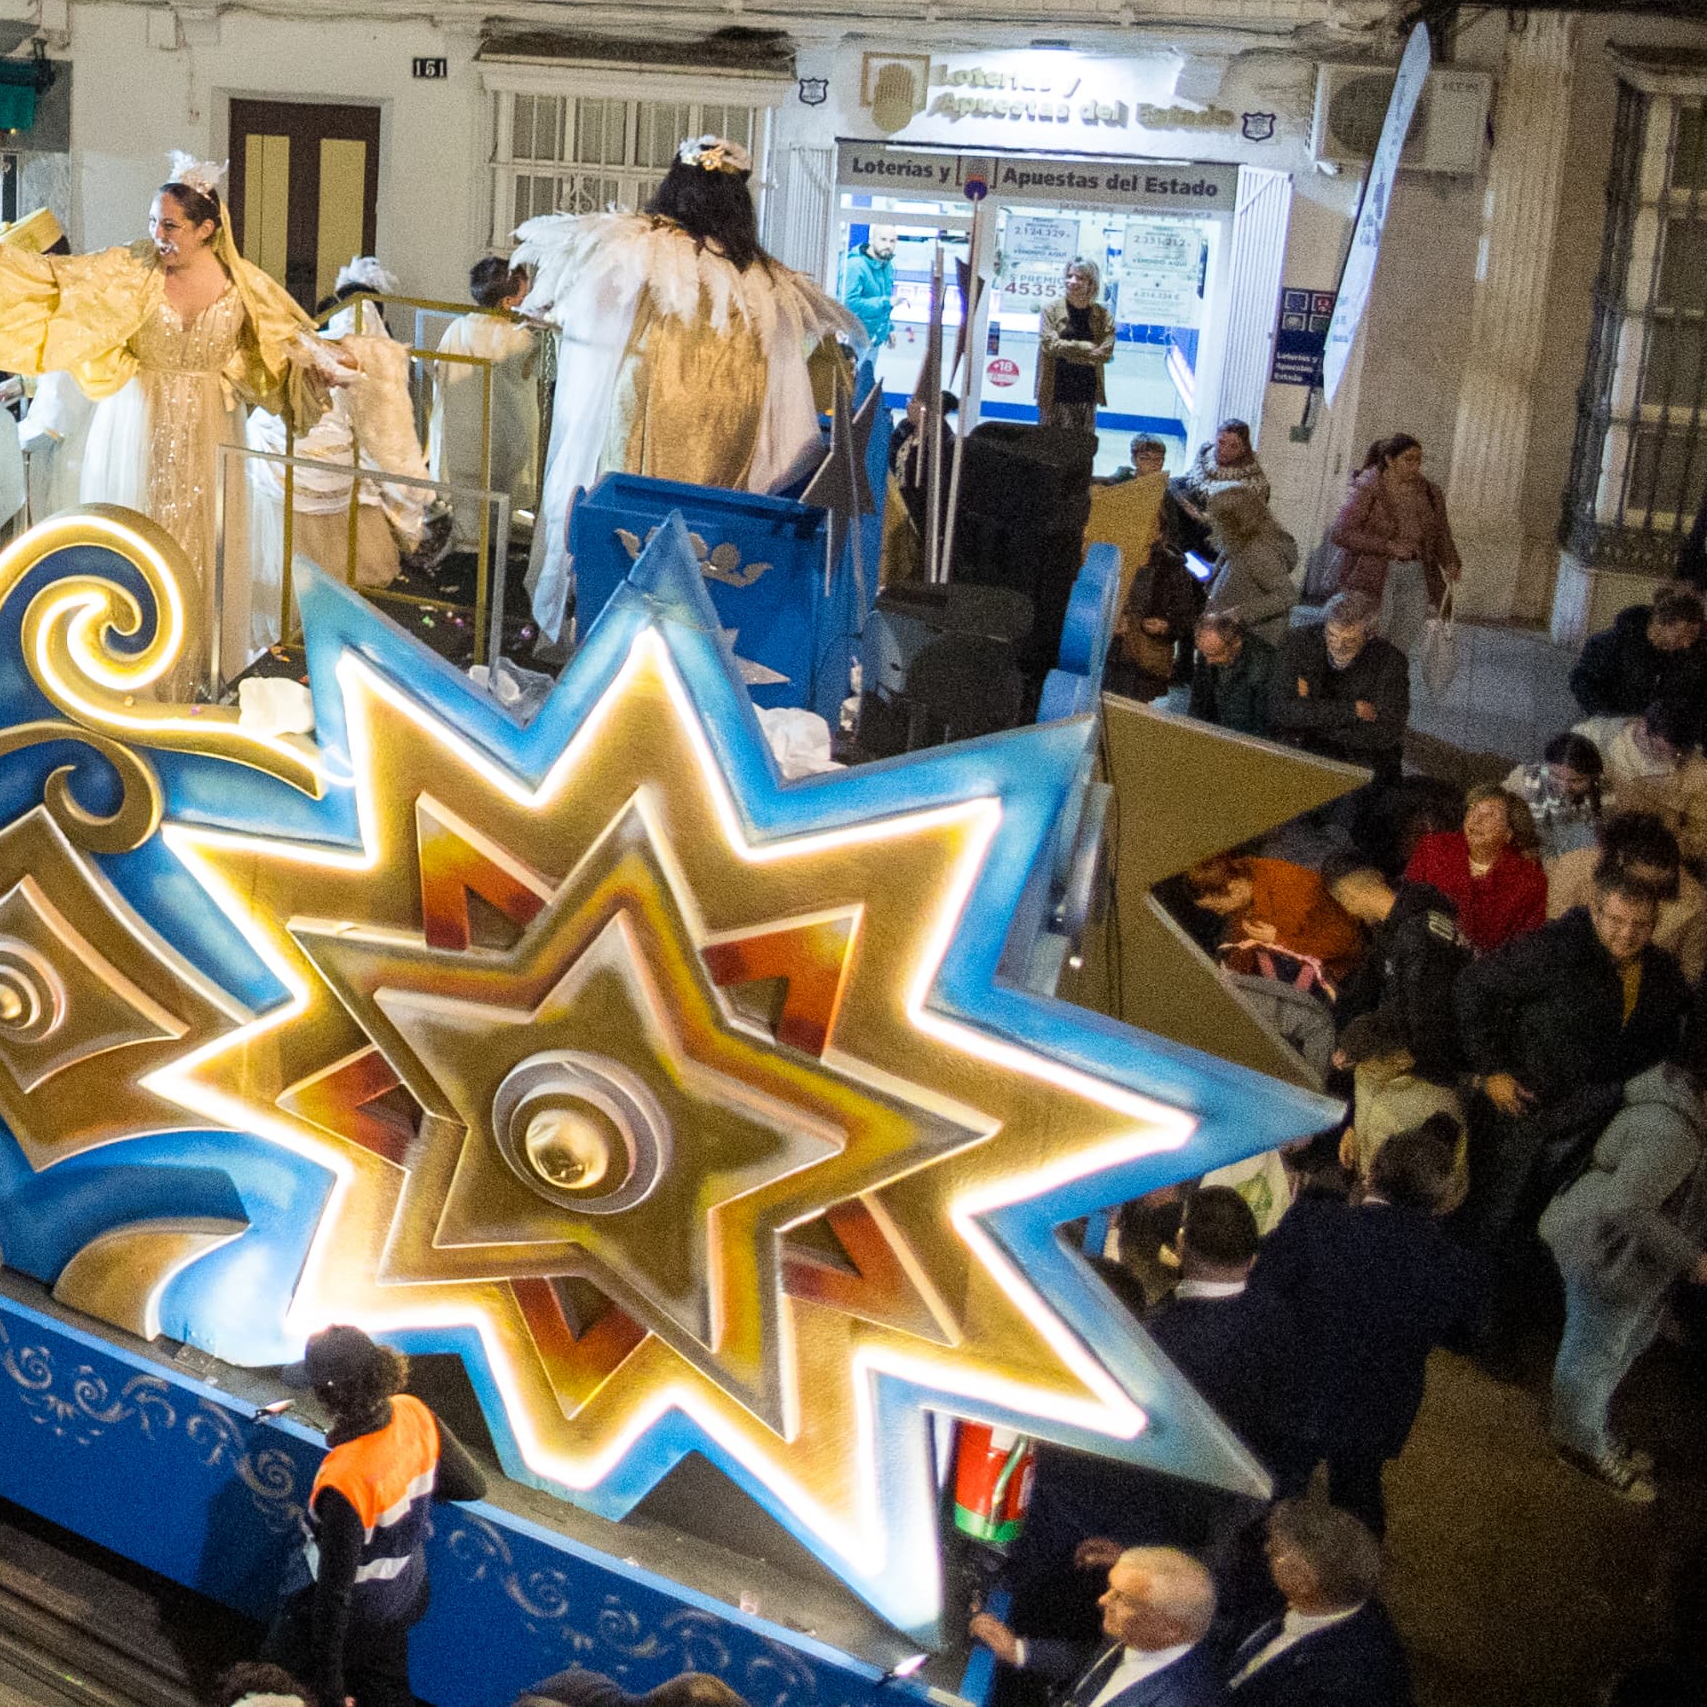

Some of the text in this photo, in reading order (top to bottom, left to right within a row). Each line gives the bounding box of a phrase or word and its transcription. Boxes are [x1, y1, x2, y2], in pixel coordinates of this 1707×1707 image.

[415, 60, 444, 76] 151
[933, 92, 1070, 123] Apuestas
[1081, 99, 1128, 128] del
[939, 165, 951, 184] y
[1002, 167, 1098, 189] Apuestas
[1106, 170, 1137, 191] del
[1145, 175, 1218, 197] Estado
[993, 361, 1013, 373] +18
